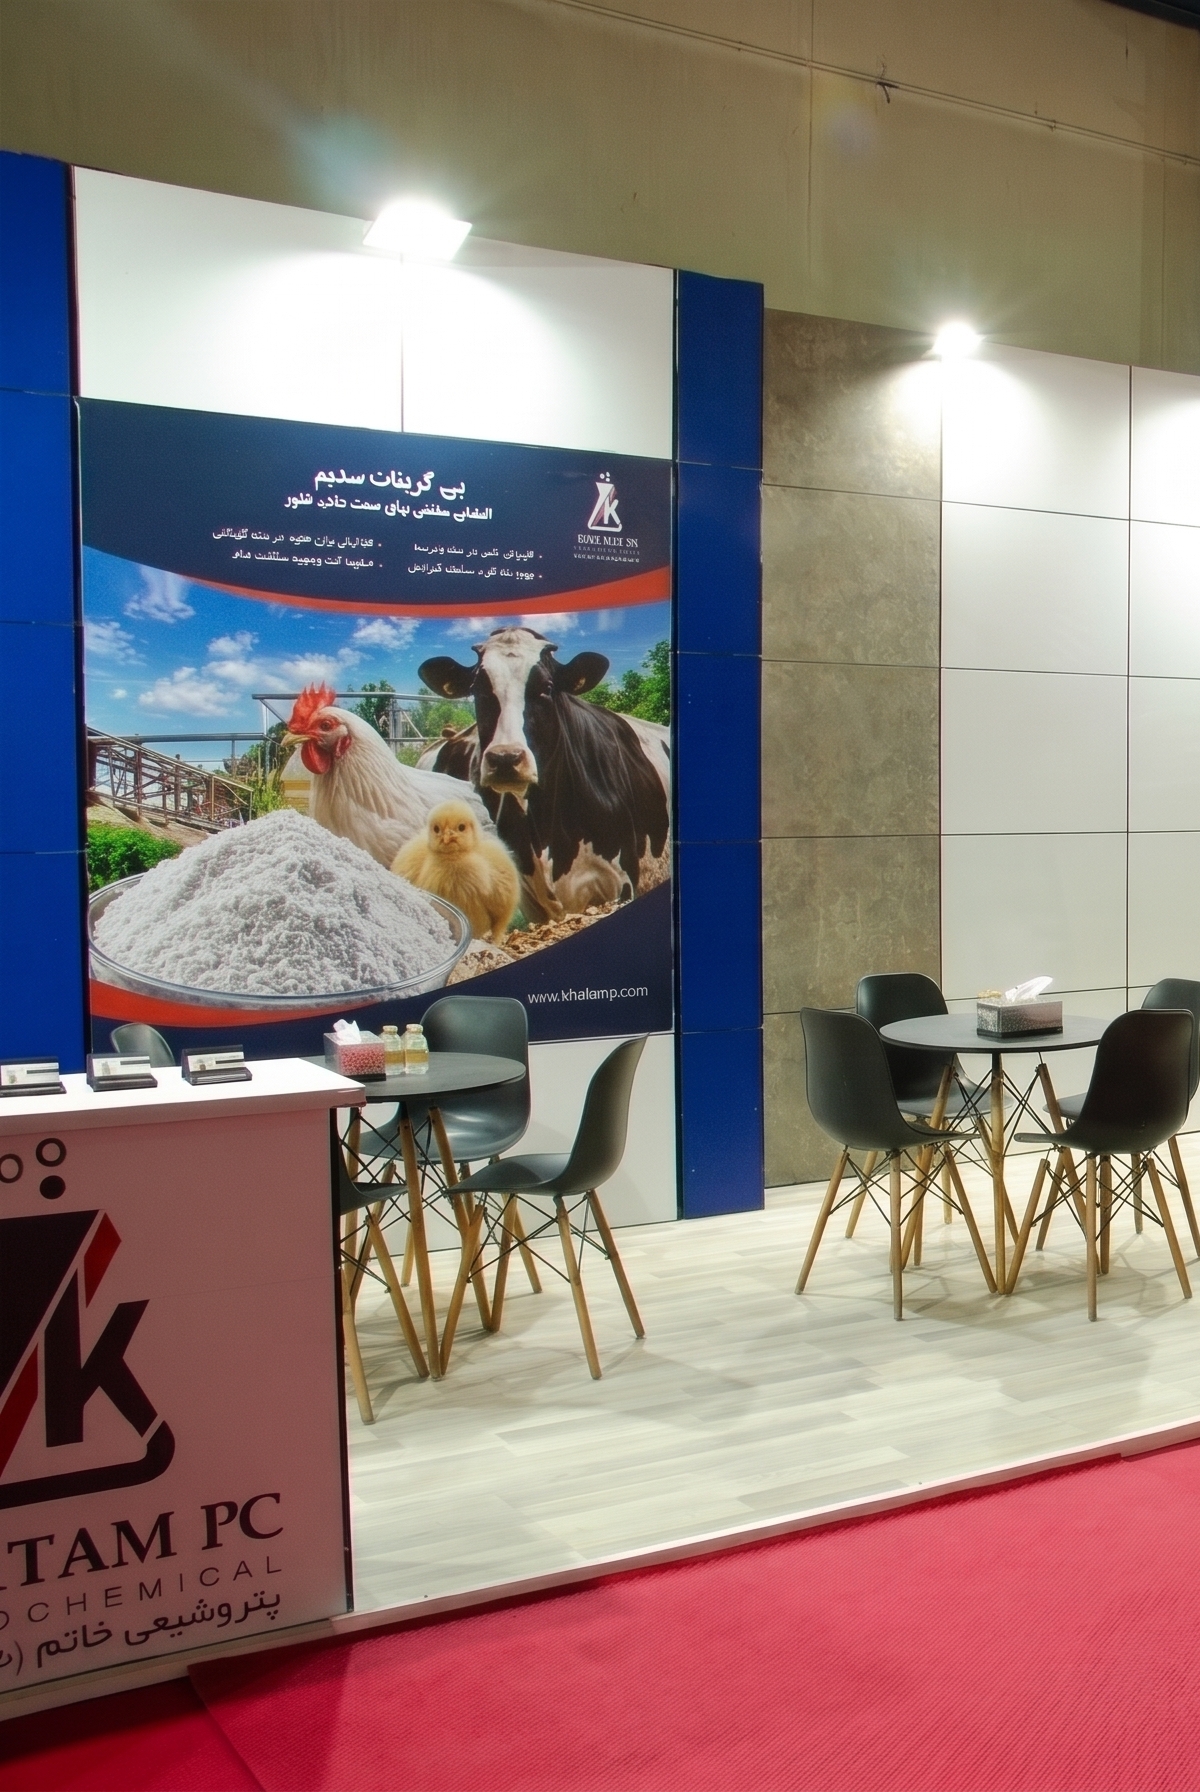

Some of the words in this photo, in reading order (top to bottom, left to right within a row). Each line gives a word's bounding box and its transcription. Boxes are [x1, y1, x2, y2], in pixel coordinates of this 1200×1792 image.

[0, 1511, 177, 1592] TAM
[200, 1492, 284, 1551] PC
[37, 1621, 113, 1669] خاتم
